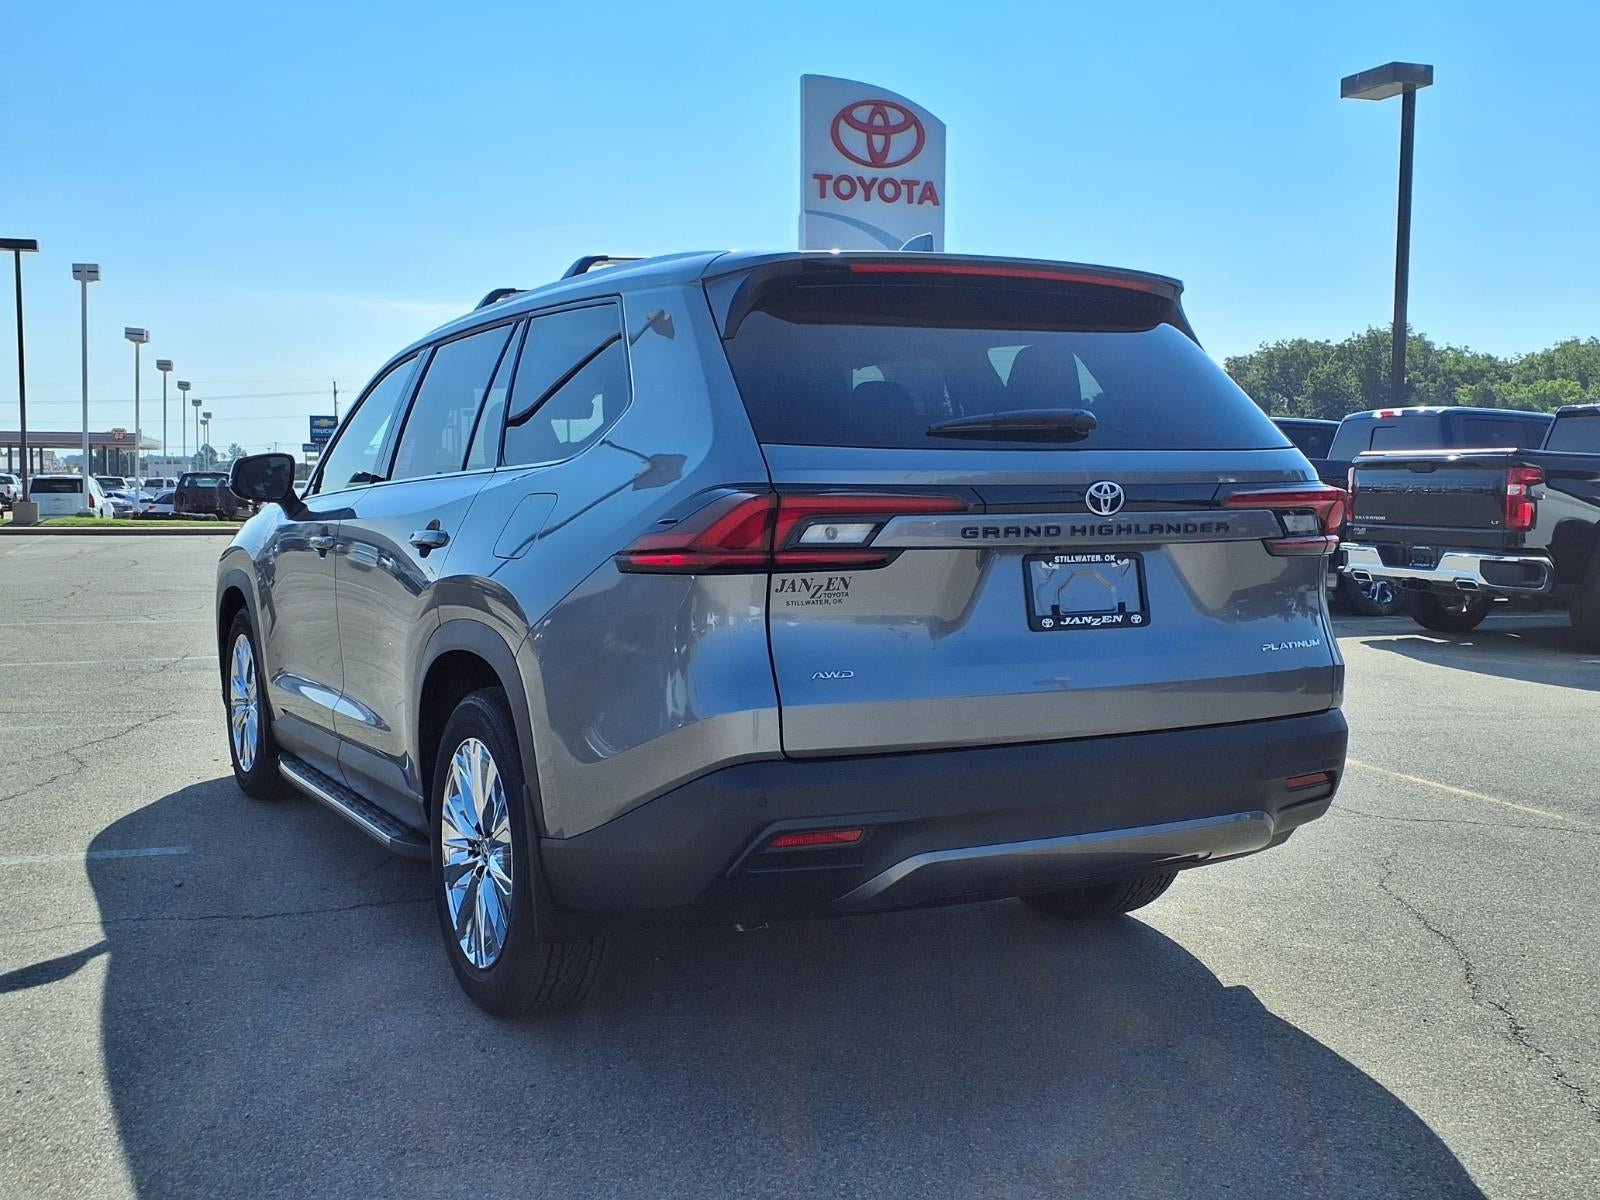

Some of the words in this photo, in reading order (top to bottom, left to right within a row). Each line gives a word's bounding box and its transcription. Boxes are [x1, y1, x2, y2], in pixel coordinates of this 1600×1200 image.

[812, 173, 940, 206] TOYOTA
[961, 525, 1062, 539] GRAND
[1070, 522, 1230, 537] HIGHLANDER
[775, 576, 853, 599] JANZEN
[1060, 615, 1124, 626] JANZEN
[1262, 638, 1320, 652] PLATINUM
[811, 670, 854, 680] AWD
